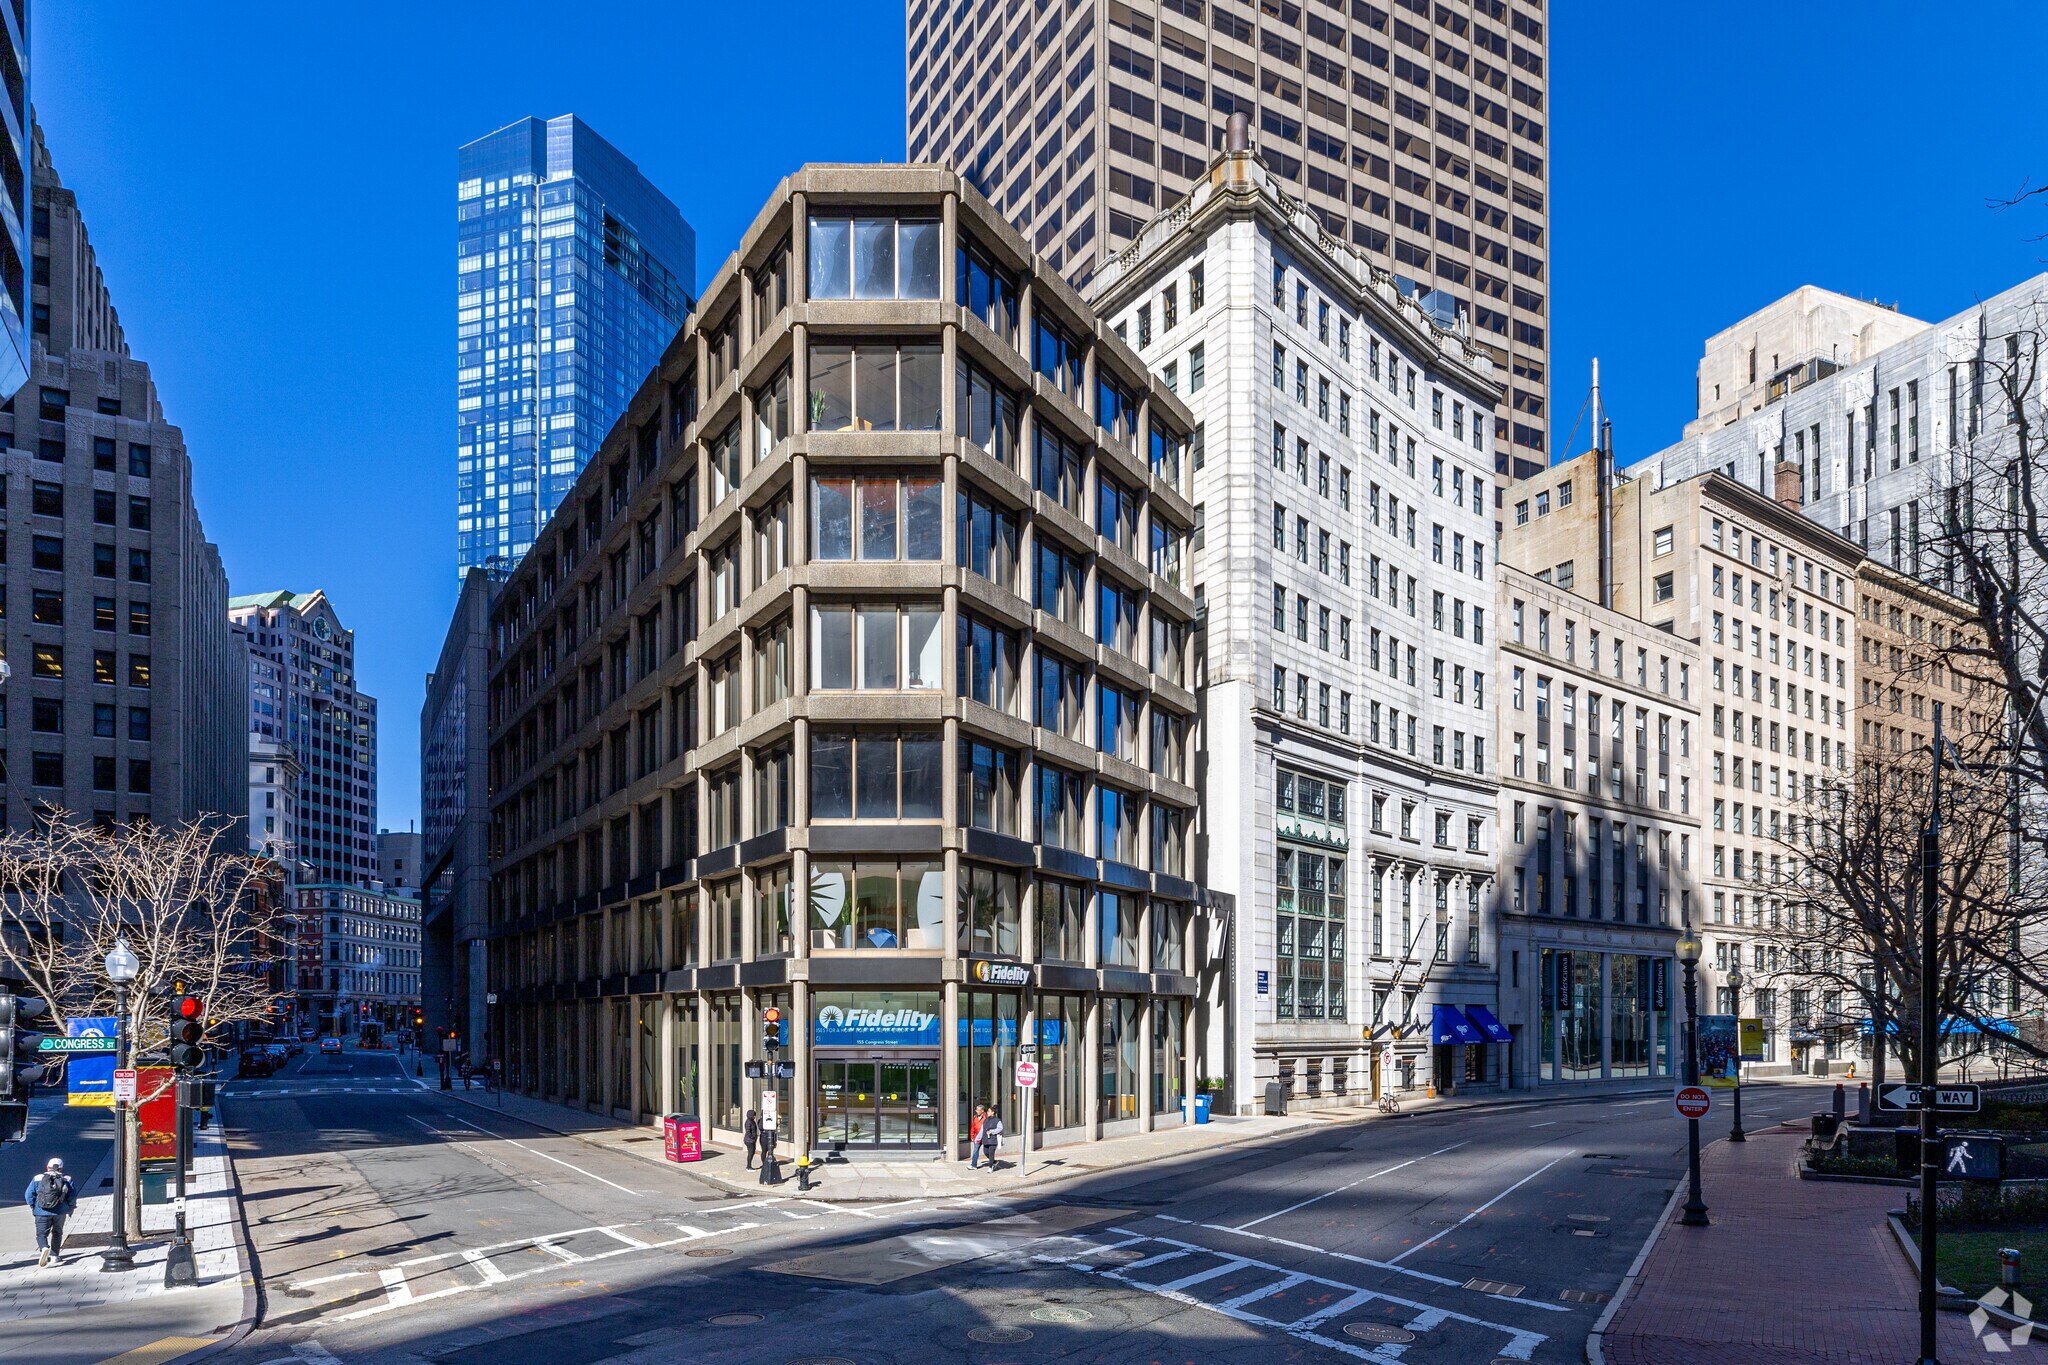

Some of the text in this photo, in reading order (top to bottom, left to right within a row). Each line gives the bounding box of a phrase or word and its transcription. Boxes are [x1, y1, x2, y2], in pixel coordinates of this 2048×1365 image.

[991, 965, 1030, 984] Fidelity
[845, 1009, 935, 1031] Fidelity
[54, 1038, 104, 1049] CONGRESS
[1942, 1092, 1968, 1103] WAY
